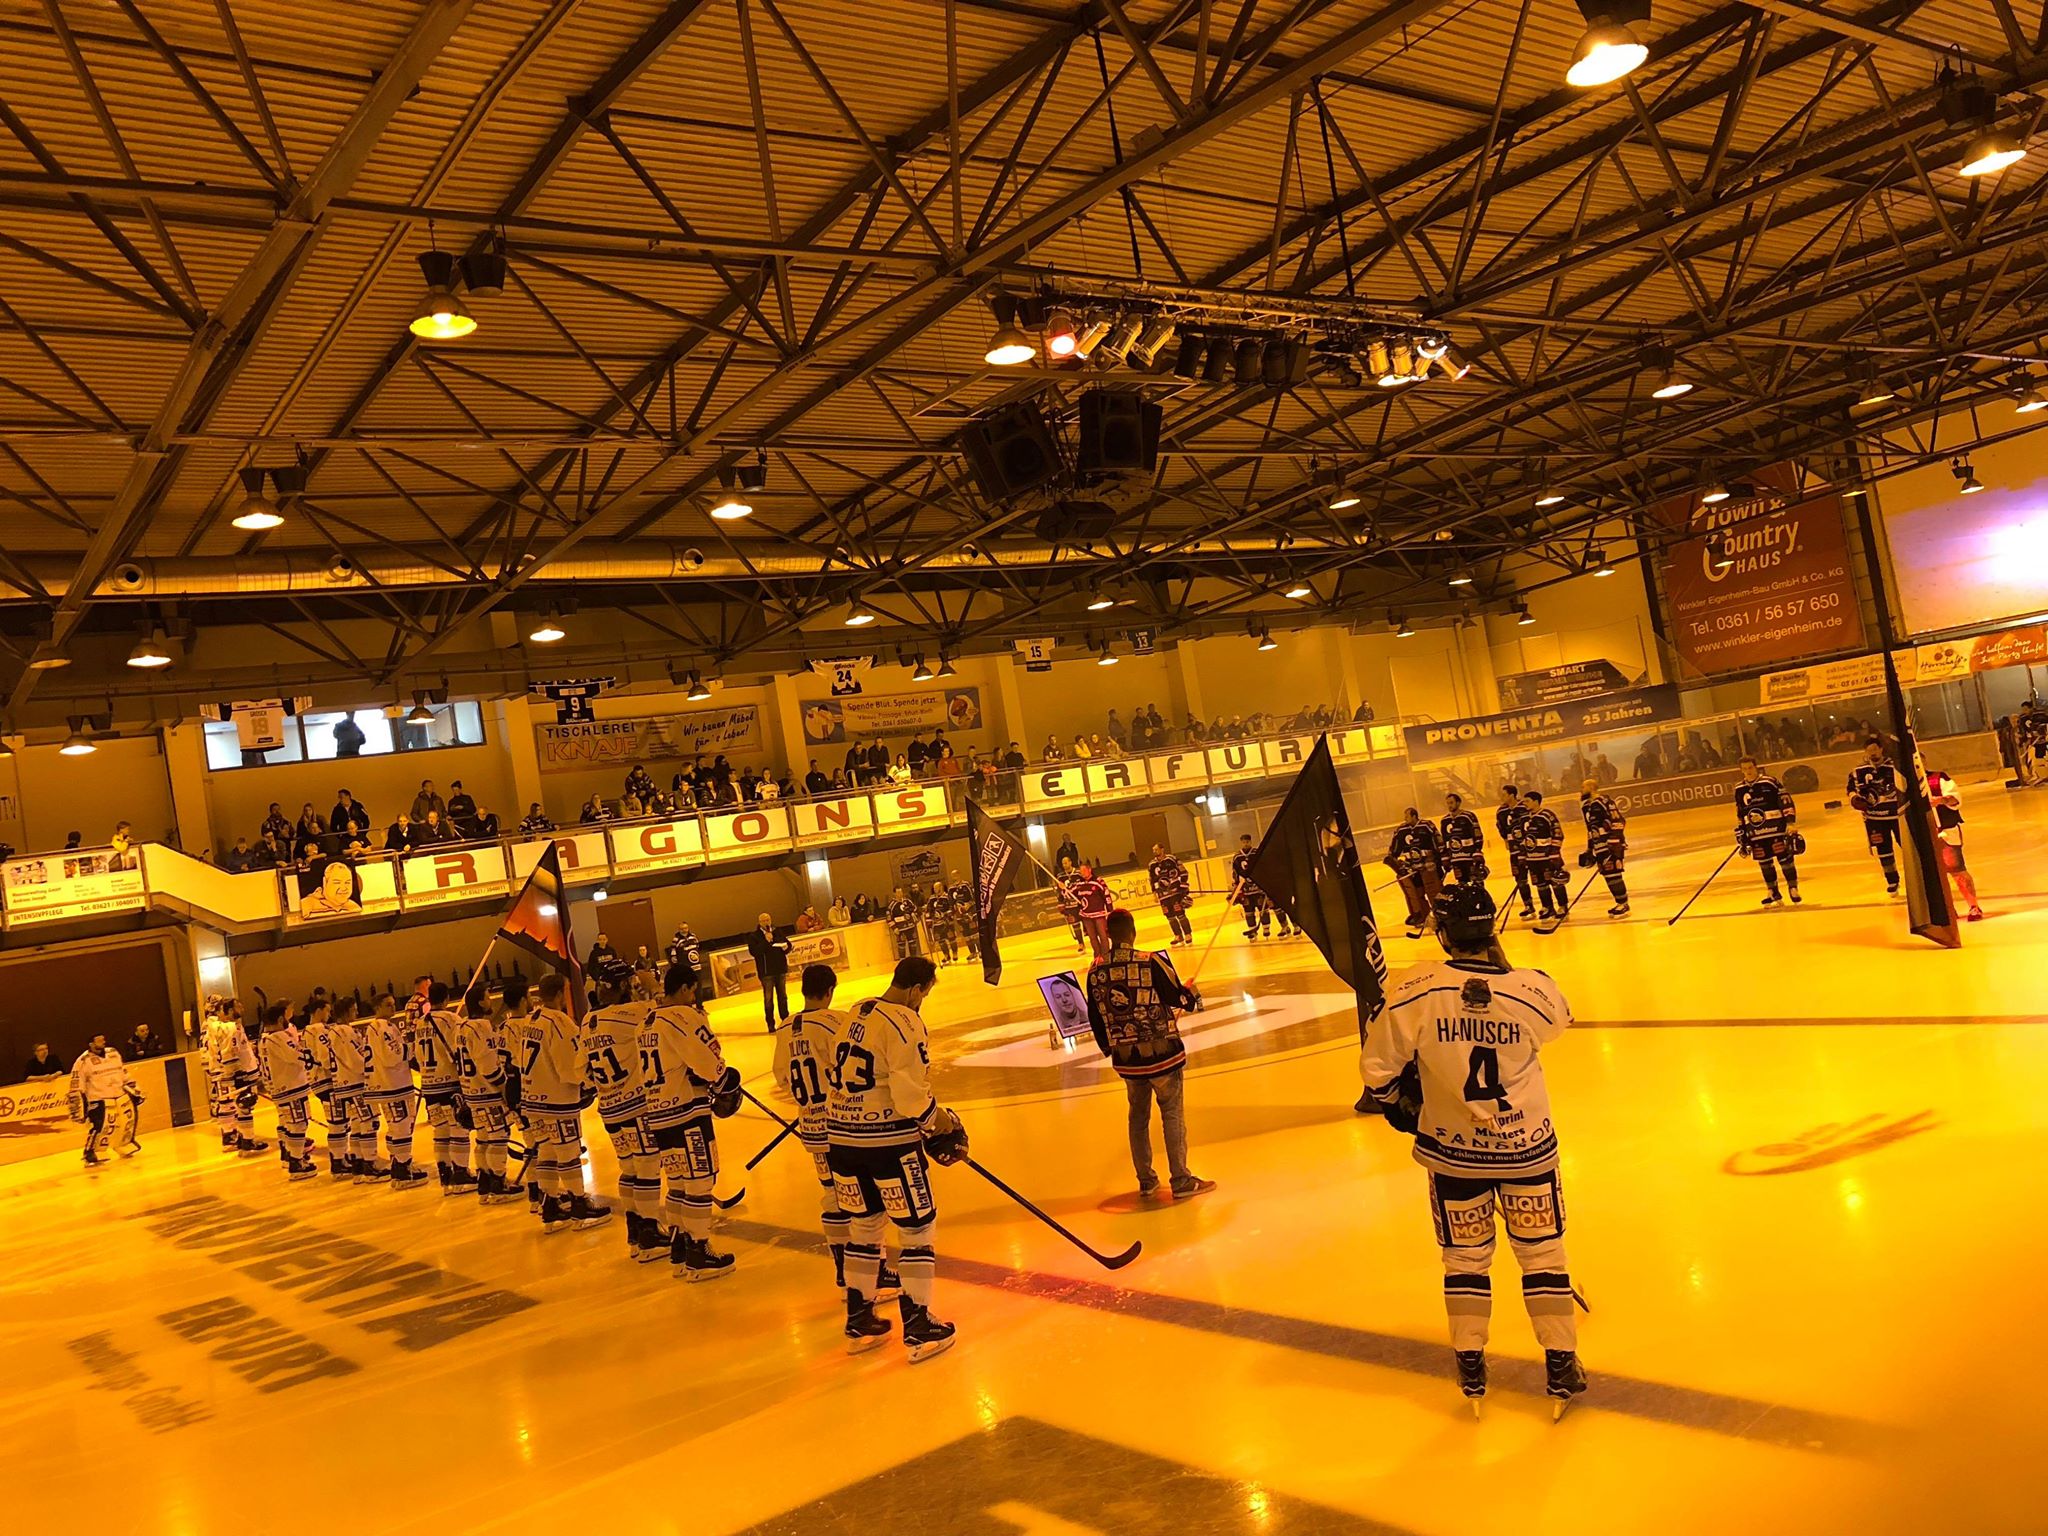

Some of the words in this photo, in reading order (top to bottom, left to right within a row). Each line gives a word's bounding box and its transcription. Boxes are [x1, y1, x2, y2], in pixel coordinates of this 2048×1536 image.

[1736, 550, 1781, 575] HAUS
[1677, 599, 1707, 612] Winkler
[1708, 584, 1770, 606] Eigenheim-Bau
[1772, 577, 1800, 591] GmbH
[1802, 575, 1809, 584] &
[1810, 572, 1827, 582] Co.
[1828, 567, 1844, 578] KG
[1690, 620, 1714, 636] Tel.
[1716, 611, 1750, 632] 0361
[1765, 604, 1783, 621] 56
[1787, 600, 1804, 617] 57
[1810, 592, 1839, 611] 650
[1694, 616, 1843, 654] www.winkler-eigenheim.de
[1031, 645, 1042, 658] 15
[836, 670, 853, 683] 24
[1550, 664, 1586, 677] SMART
[571, 697, 580, 712] 9
[847, 702, 874, 713] Spende
[875, 700, 892, 709] Blut.
[893, 697, 919, 708] Spende
[920, 695, 938, 707] jetzt.
[683, 724, 699, 737] Wir
[702, 720, 726, 734] bauen
[729, 710, 754, 725] Möbel
[1582, 714, 1600, 726] 25
[1604, 705, 1653, 722] Jahren
[546, 723, 636, 739] TISCHLEREI
[723, 726, 749, 742] Leben!
[1426, 710, 1563, 746] PROVENTA
[1517, 727, 1564, 741] ERFURT
[1041, 733, 1347, 798] ERFURT
[14, 908, 64, 921] INTENSIVPFLEGE
[1436, 1017, 1521, 1045] HANUSCH
[418, 1039, 438, 1068] 11
[790, 1057, 827, 1107] 81
[1463, 1045, 1513, 1112] 4
[19, 1092, 57, 1106] erfurter
[1451, 1200, 1494, 1225] LIQUI
[1502, 1194, 1551, 1213] LIQUI
[1453, 1217, 1495, 1239] MOLY
[1507, 1210, 1552, 1228] MOLY
